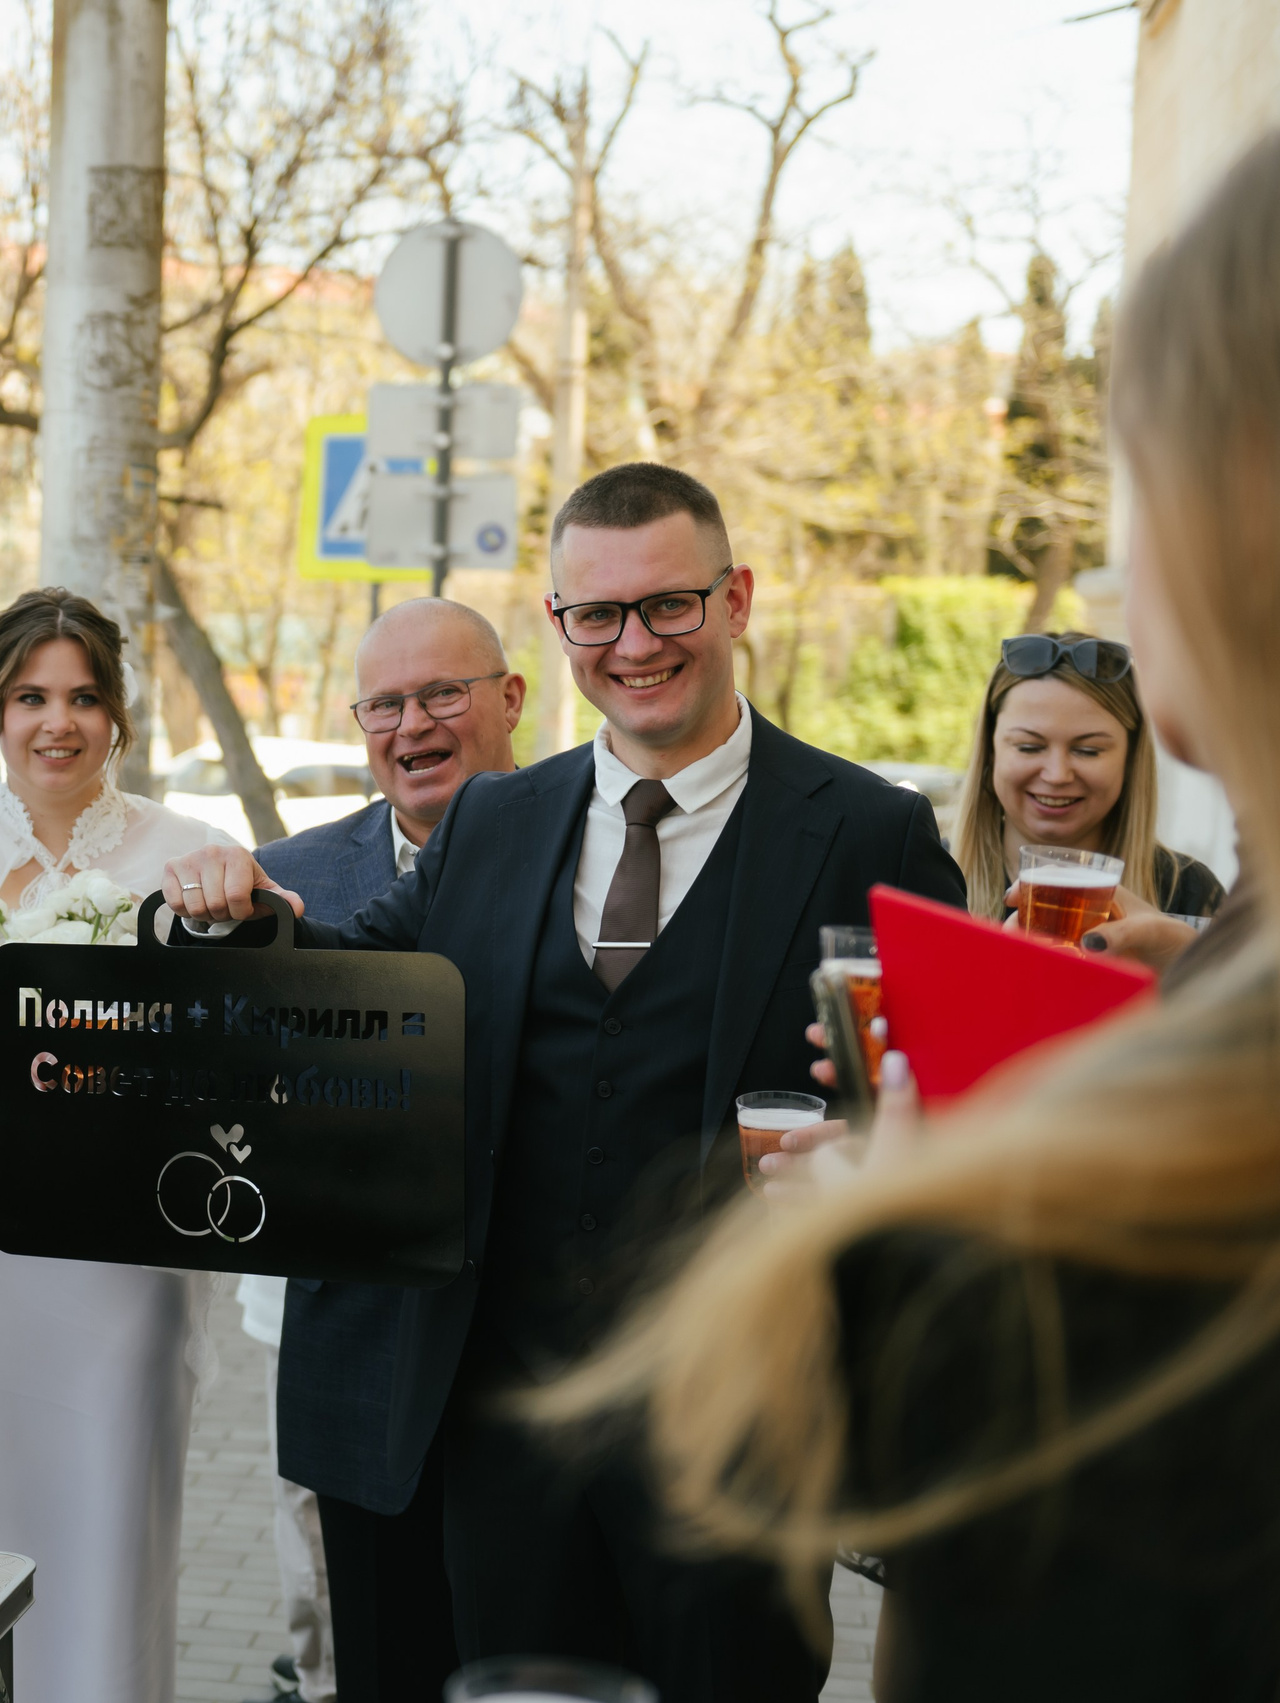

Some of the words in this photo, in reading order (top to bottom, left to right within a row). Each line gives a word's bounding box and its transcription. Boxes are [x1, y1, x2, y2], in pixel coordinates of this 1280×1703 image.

[18, 987, 173, 1033] Полина
[222, 993, 389, 1048] Кирилл
[30, 1051, 154, 1097] Совет
